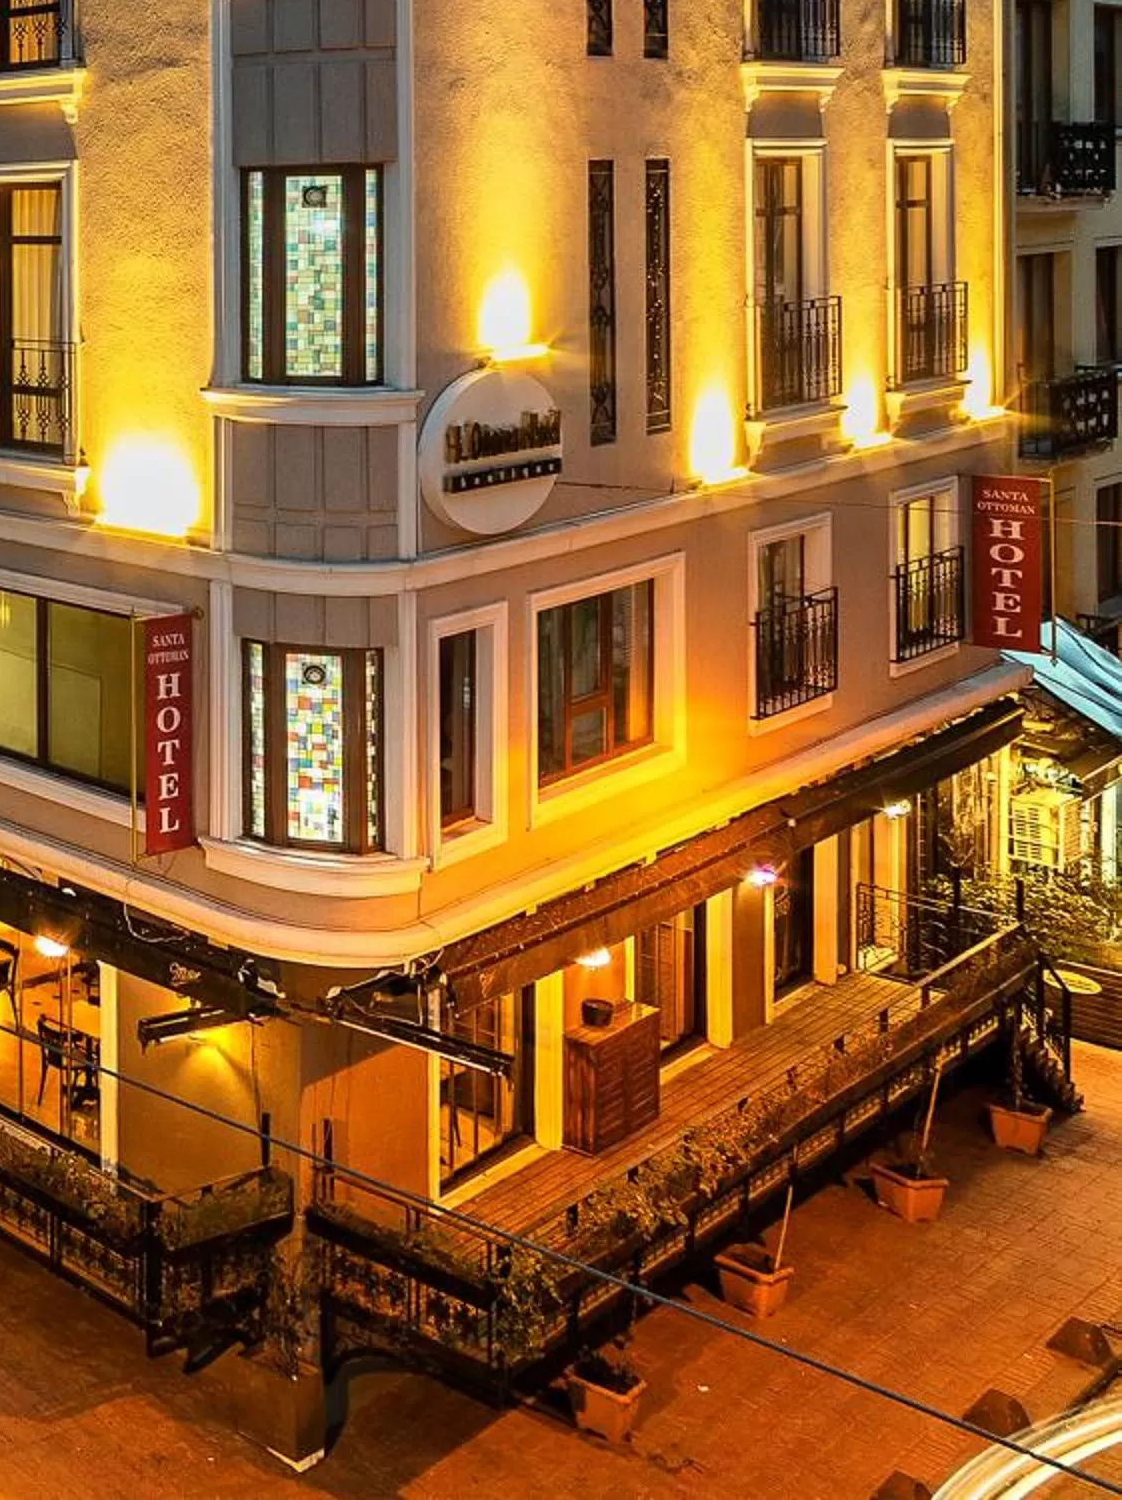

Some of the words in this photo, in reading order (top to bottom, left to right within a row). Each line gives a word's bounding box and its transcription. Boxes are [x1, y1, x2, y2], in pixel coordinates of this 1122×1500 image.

[982, 489, 1029, 502] SANTA
[977, 501, 1036, 516] OTTOMAN
[989, 518, 1026, 638] HOTEL
[152, 633, 185, 647] SANTA
[156, 672, 182, 834] HOTEL
